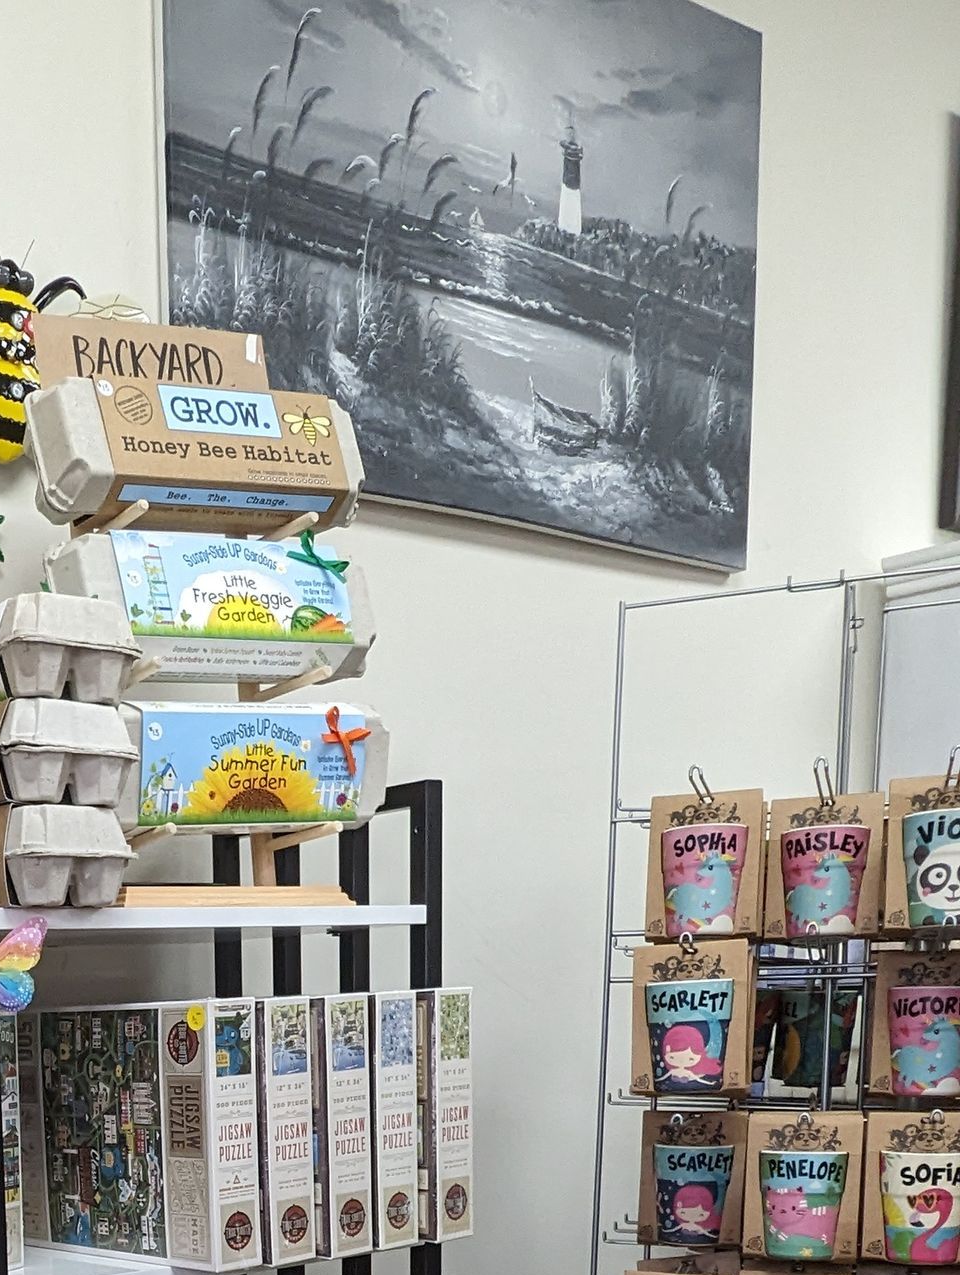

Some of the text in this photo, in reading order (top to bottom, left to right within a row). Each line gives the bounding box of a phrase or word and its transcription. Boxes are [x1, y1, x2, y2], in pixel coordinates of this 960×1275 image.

[72, 335, 223, 386] BACKYARD
[171, 395, 271, 430] GROW.
[121, 436, 332, 466] Honey Bee Habitat
[167, 491, 289, 507] Bee. The. Change.
[228, 542, 242, 558] UP
[243, 547, 278, 571] Gardens
[223, 575, 256, 590] Little
[193, 588, 235, 605] Fresh
[237, 591, 294, 610] Veggie
[217, 606, 276, 624] Garden
[211, 718, 302, 750] Sunny-Side UP Gardens
[246, 743, 274, 758] Little
[208, 756, 277, 773] Summer
[282, 756, 307, 771] Fun
[228, 774, 287, 790] Garden
[651, 989, 729, 1013] SCARLETT
[169, 1085, 184, 1150] PUZZLE
[185, 1085, 201, 1151] JIGSAW
[382, 1111, 413, 1131] JIGSAW
[441, 1105, 469, 1123] JIGSAW
[219, 1123, 253, 1142] JIGSAW
[274, 1121, 308, 1141] JIGSAW
[334, 1117, 366, 1136] JIGSAW
[442, 1124, 469, 1143] PUZZLE
[335, 1137, 366, 1157] PUZZLE
[383, 1131, 413, 1149] PUZZLE
[219, 1143, 253, 1163] PUZZLE
[275, 1142, 309, 1162] PUZZLE
[768, 1158, 843, 1182] PENELOPE
